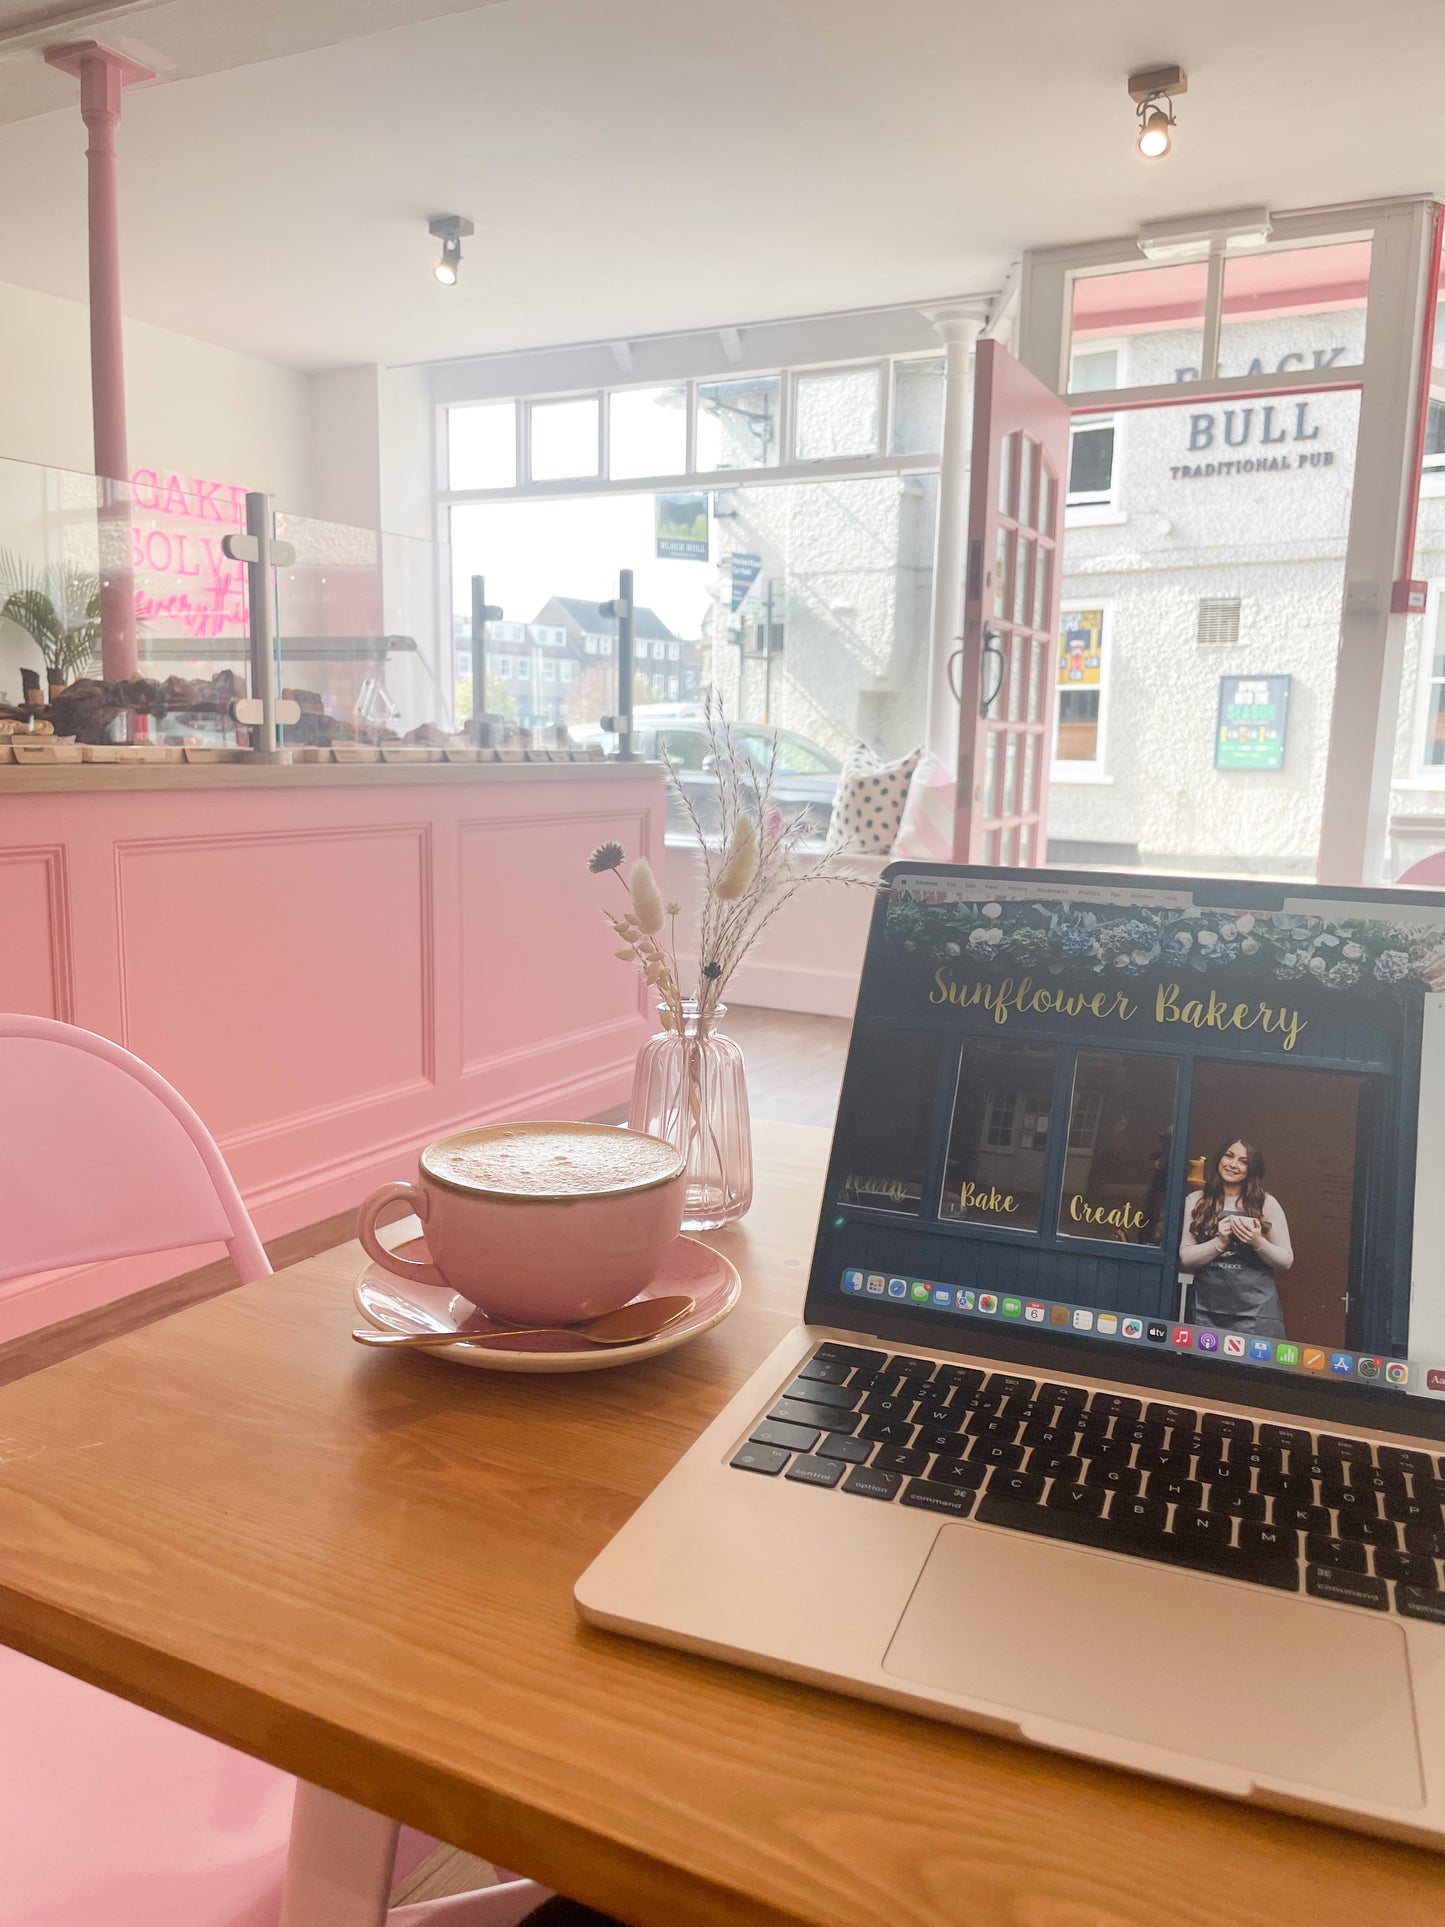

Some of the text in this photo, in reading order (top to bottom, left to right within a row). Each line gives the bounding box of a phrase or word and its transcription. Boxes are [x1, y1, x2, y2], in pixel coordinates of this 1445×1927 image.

[1188, 402, 1319, 451] BULL
[1170, 452, 1334, 480] TRADITIONAL PUB
[929, 966, 1308, 1051] Sunflower Bakery
[960, 1181, 1019, 1213] Bake
[1069, 1194, 1150, 1230] Create
[1031, 1309, 1038, 1319] 6
[1156, 1328, 1165, 1337] tv
[881, 1401, 892, 1410] Q
[933, 1411, 947, 1420] W
[988, 1422, 998, 1430] E
[1078, 1420, 1087, 1428] 5
[880, 1426, 891, 1434] A
[1043, 1433, 1053, 1441] R
[1133, 1431, 1143, 1439] 6
[935, 1436, 946, 1445] S
[991, 1448, 1003, 1456] D
[1100, 1444, 1110, 1452] T
[895, 1454, 907, 1464] Z
[1159, 1456, 1169, 1464] Y
[1250, 1454, 1260, 1462] 8
[795, 1467, 831, 1481] control
[952, 1466, 964, 1476] X
[1218, 1468, 1230, 1477] U
[1311, 1466, 1322, 1474] 9
[1108, 1472, 1119, 1481] G
[1011, 1479, 1023, 1488] C
[1283, 1481, 1288, 1489] I
[1373, 1478, 1384, 1486] 0
[855, 1481, 888, 1494] option
[1168, 1484, 1181, 1494] H
[1072, 1491, 1083, 1501] V
[1342, 1493, 1356, 1502] O
[910, 1493, 962, 1509] command
[1232, 1498, 1242, 1506] J
[1133, 1504, 1144, 1514] B
[1409, 1505, 1420, 1514] P
[1296, 1510, 1308, 1520] K
[1196, 1518, 1209, 1528] N
[1363, 1524, 1373, 1534] L
[1261, 1532, 1276, 1543] M
